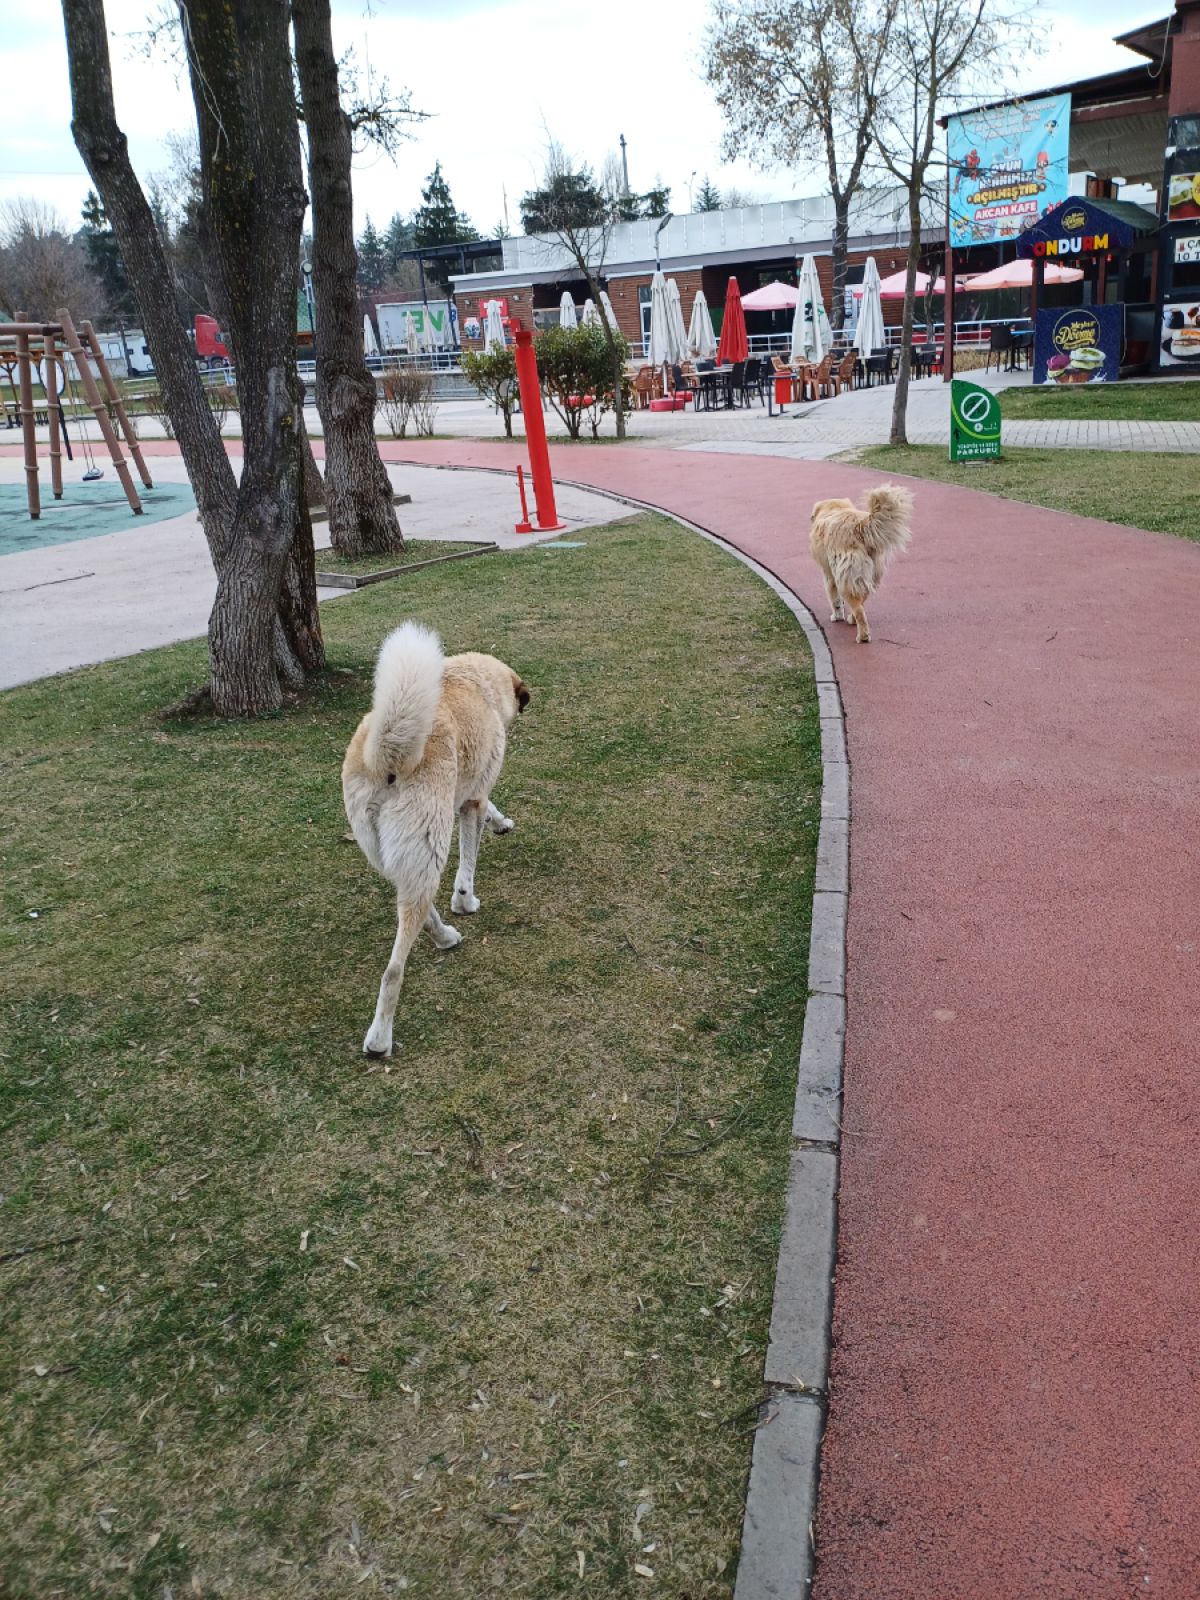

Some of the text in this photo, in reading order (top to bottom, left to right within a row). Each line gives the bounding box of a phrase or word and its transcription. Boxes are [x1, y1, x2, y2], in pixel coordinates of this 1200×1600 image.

[975, 201, 1037, 220] AKCAN KAFE
[1178, 252, 1190, 262] 10
[957, 447, 998, 456] PARKURU
